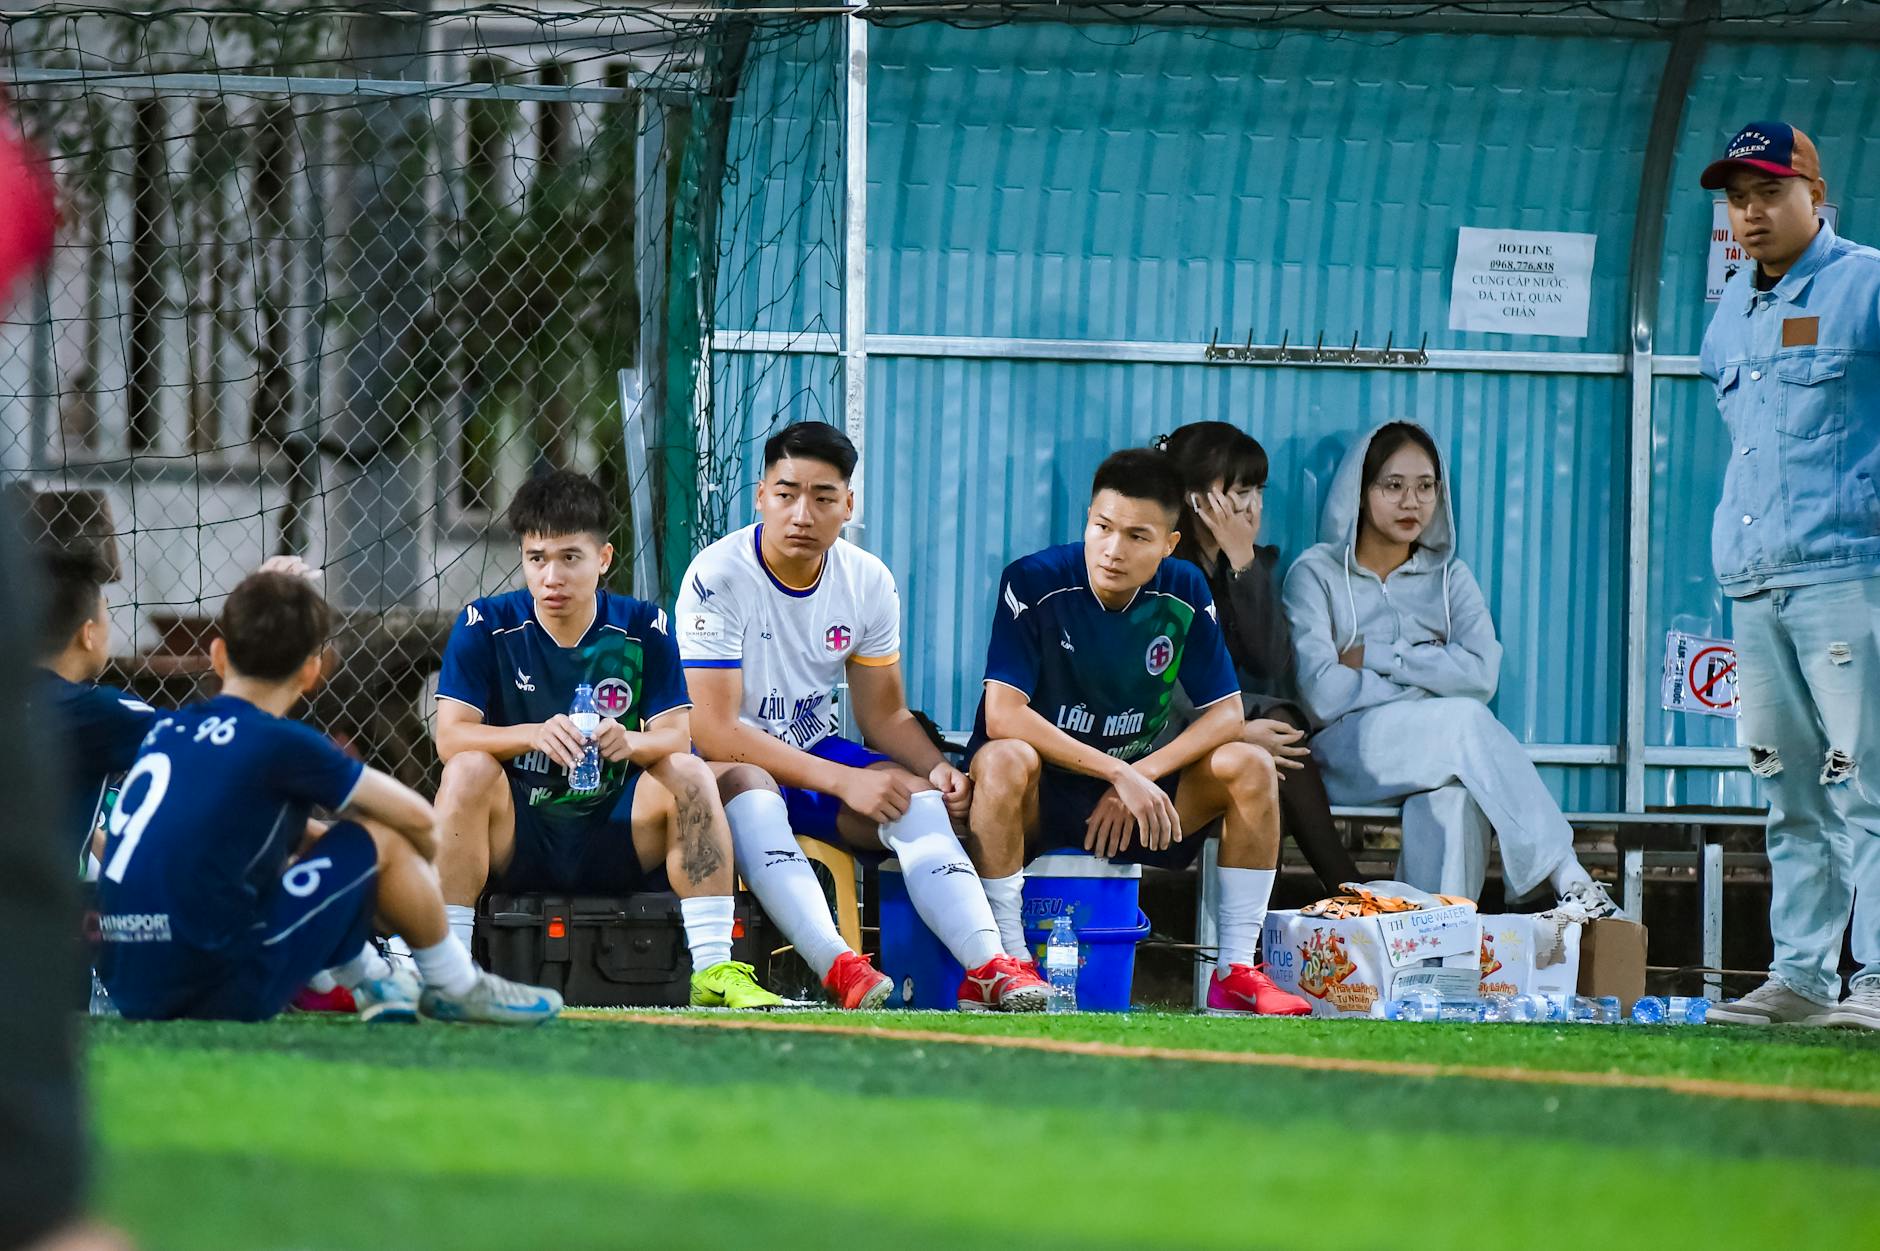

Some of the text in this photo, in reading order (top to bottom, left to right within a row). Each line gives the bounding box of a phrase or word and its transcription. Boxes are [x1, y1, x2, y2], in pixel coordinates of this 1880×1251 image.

[1498, 243, 1552, 256] HOTLINE
[1725, 245, 1741, 260] TÀI
[1472, 274, 1504, 286] CUNG
[757, 688, 786, 720] LẨU
[1056, 702, 1145, 737] LẨU NẤM
[193, 716, 238, 746] 96
[105, 751, 172, 885] 9
[1022, 898, 1063, 917] ATSU
[1411, 913, 1434, 927] true
[1434, 906, 1467, 921] WATER
[1268, 929, 1282, 945] TH
[1268, 946, 1293, 967] true
